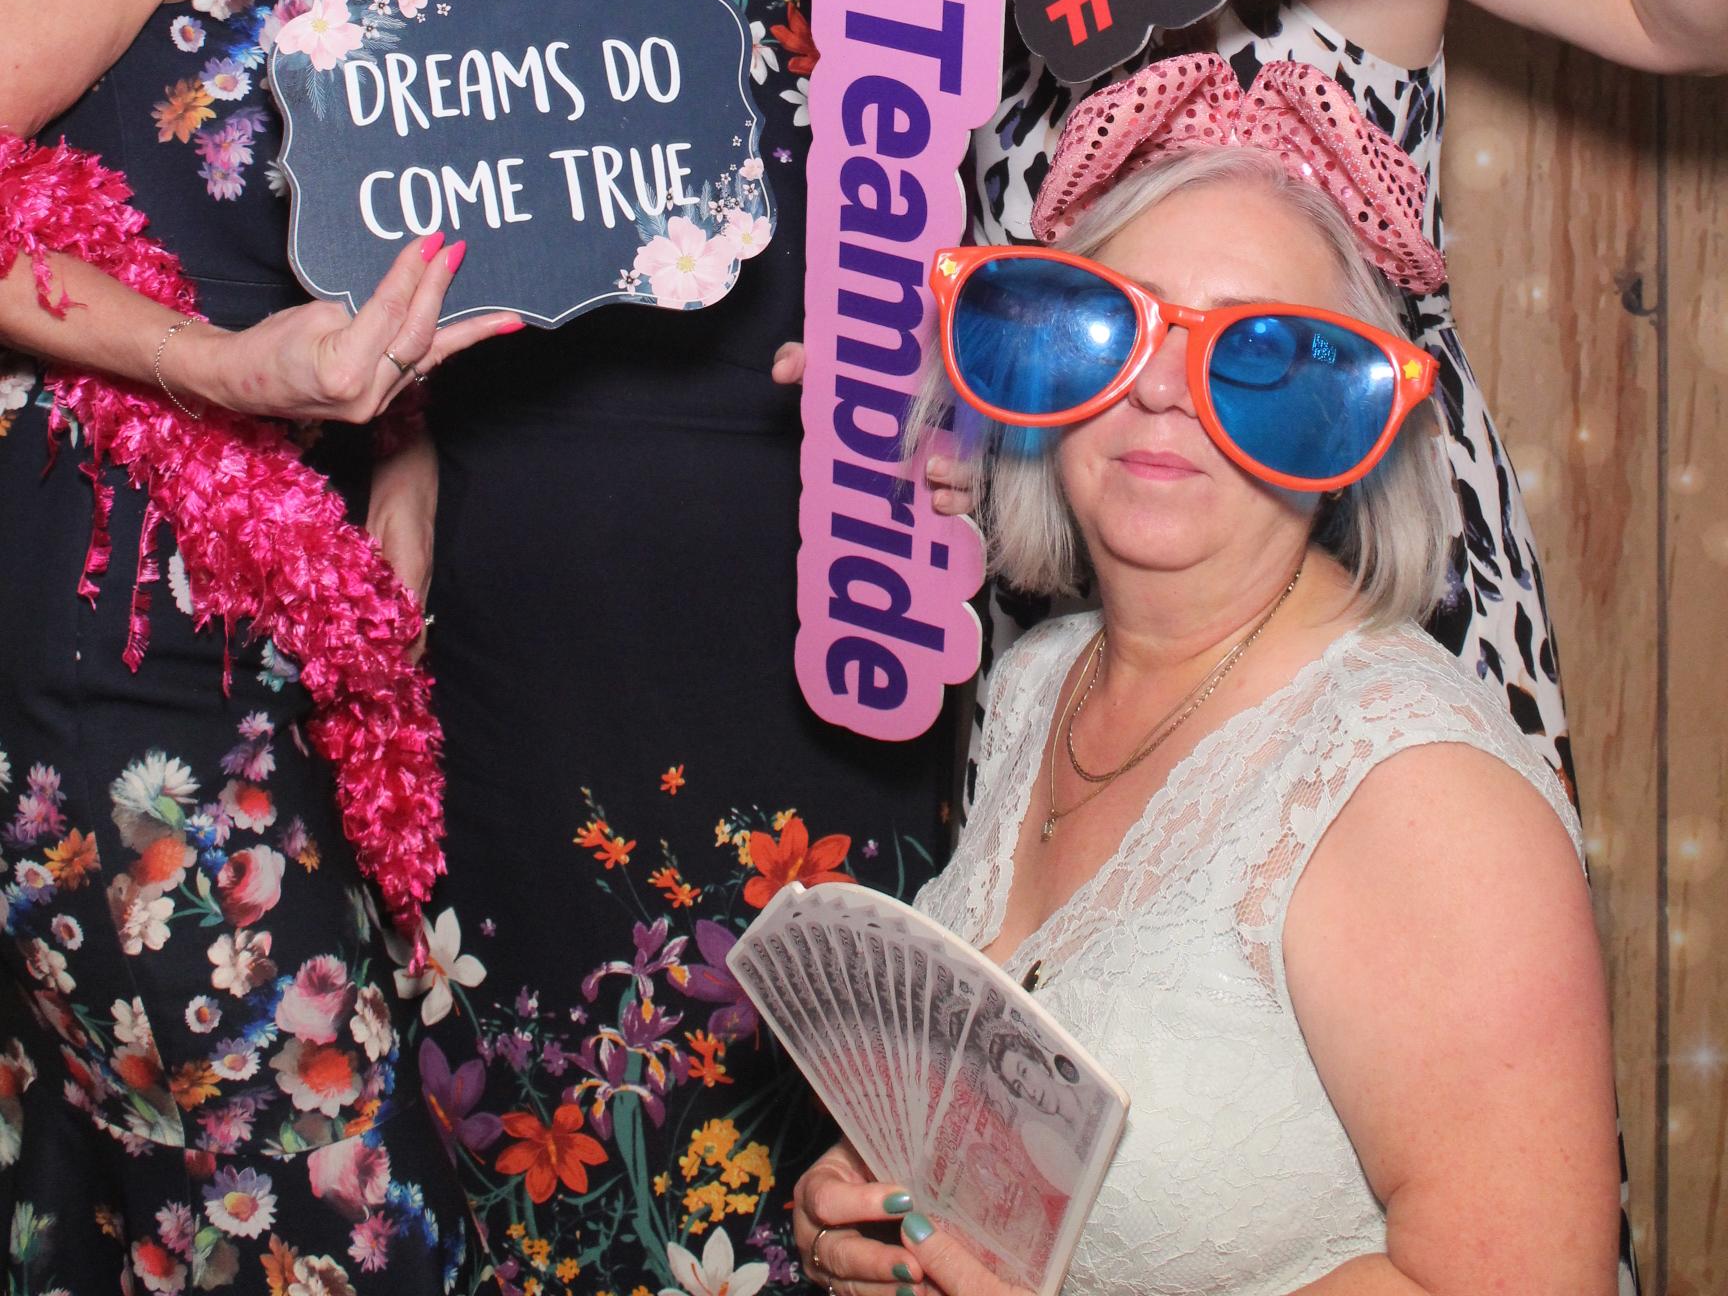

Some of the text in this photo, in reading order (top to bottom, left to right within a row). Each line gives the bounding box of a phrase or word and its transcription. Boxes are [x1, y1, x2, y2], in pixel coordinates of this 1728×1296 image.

[344, 36, 681, 137] DREAMS DO
[359, 142, 700, 240] COME TRUE
